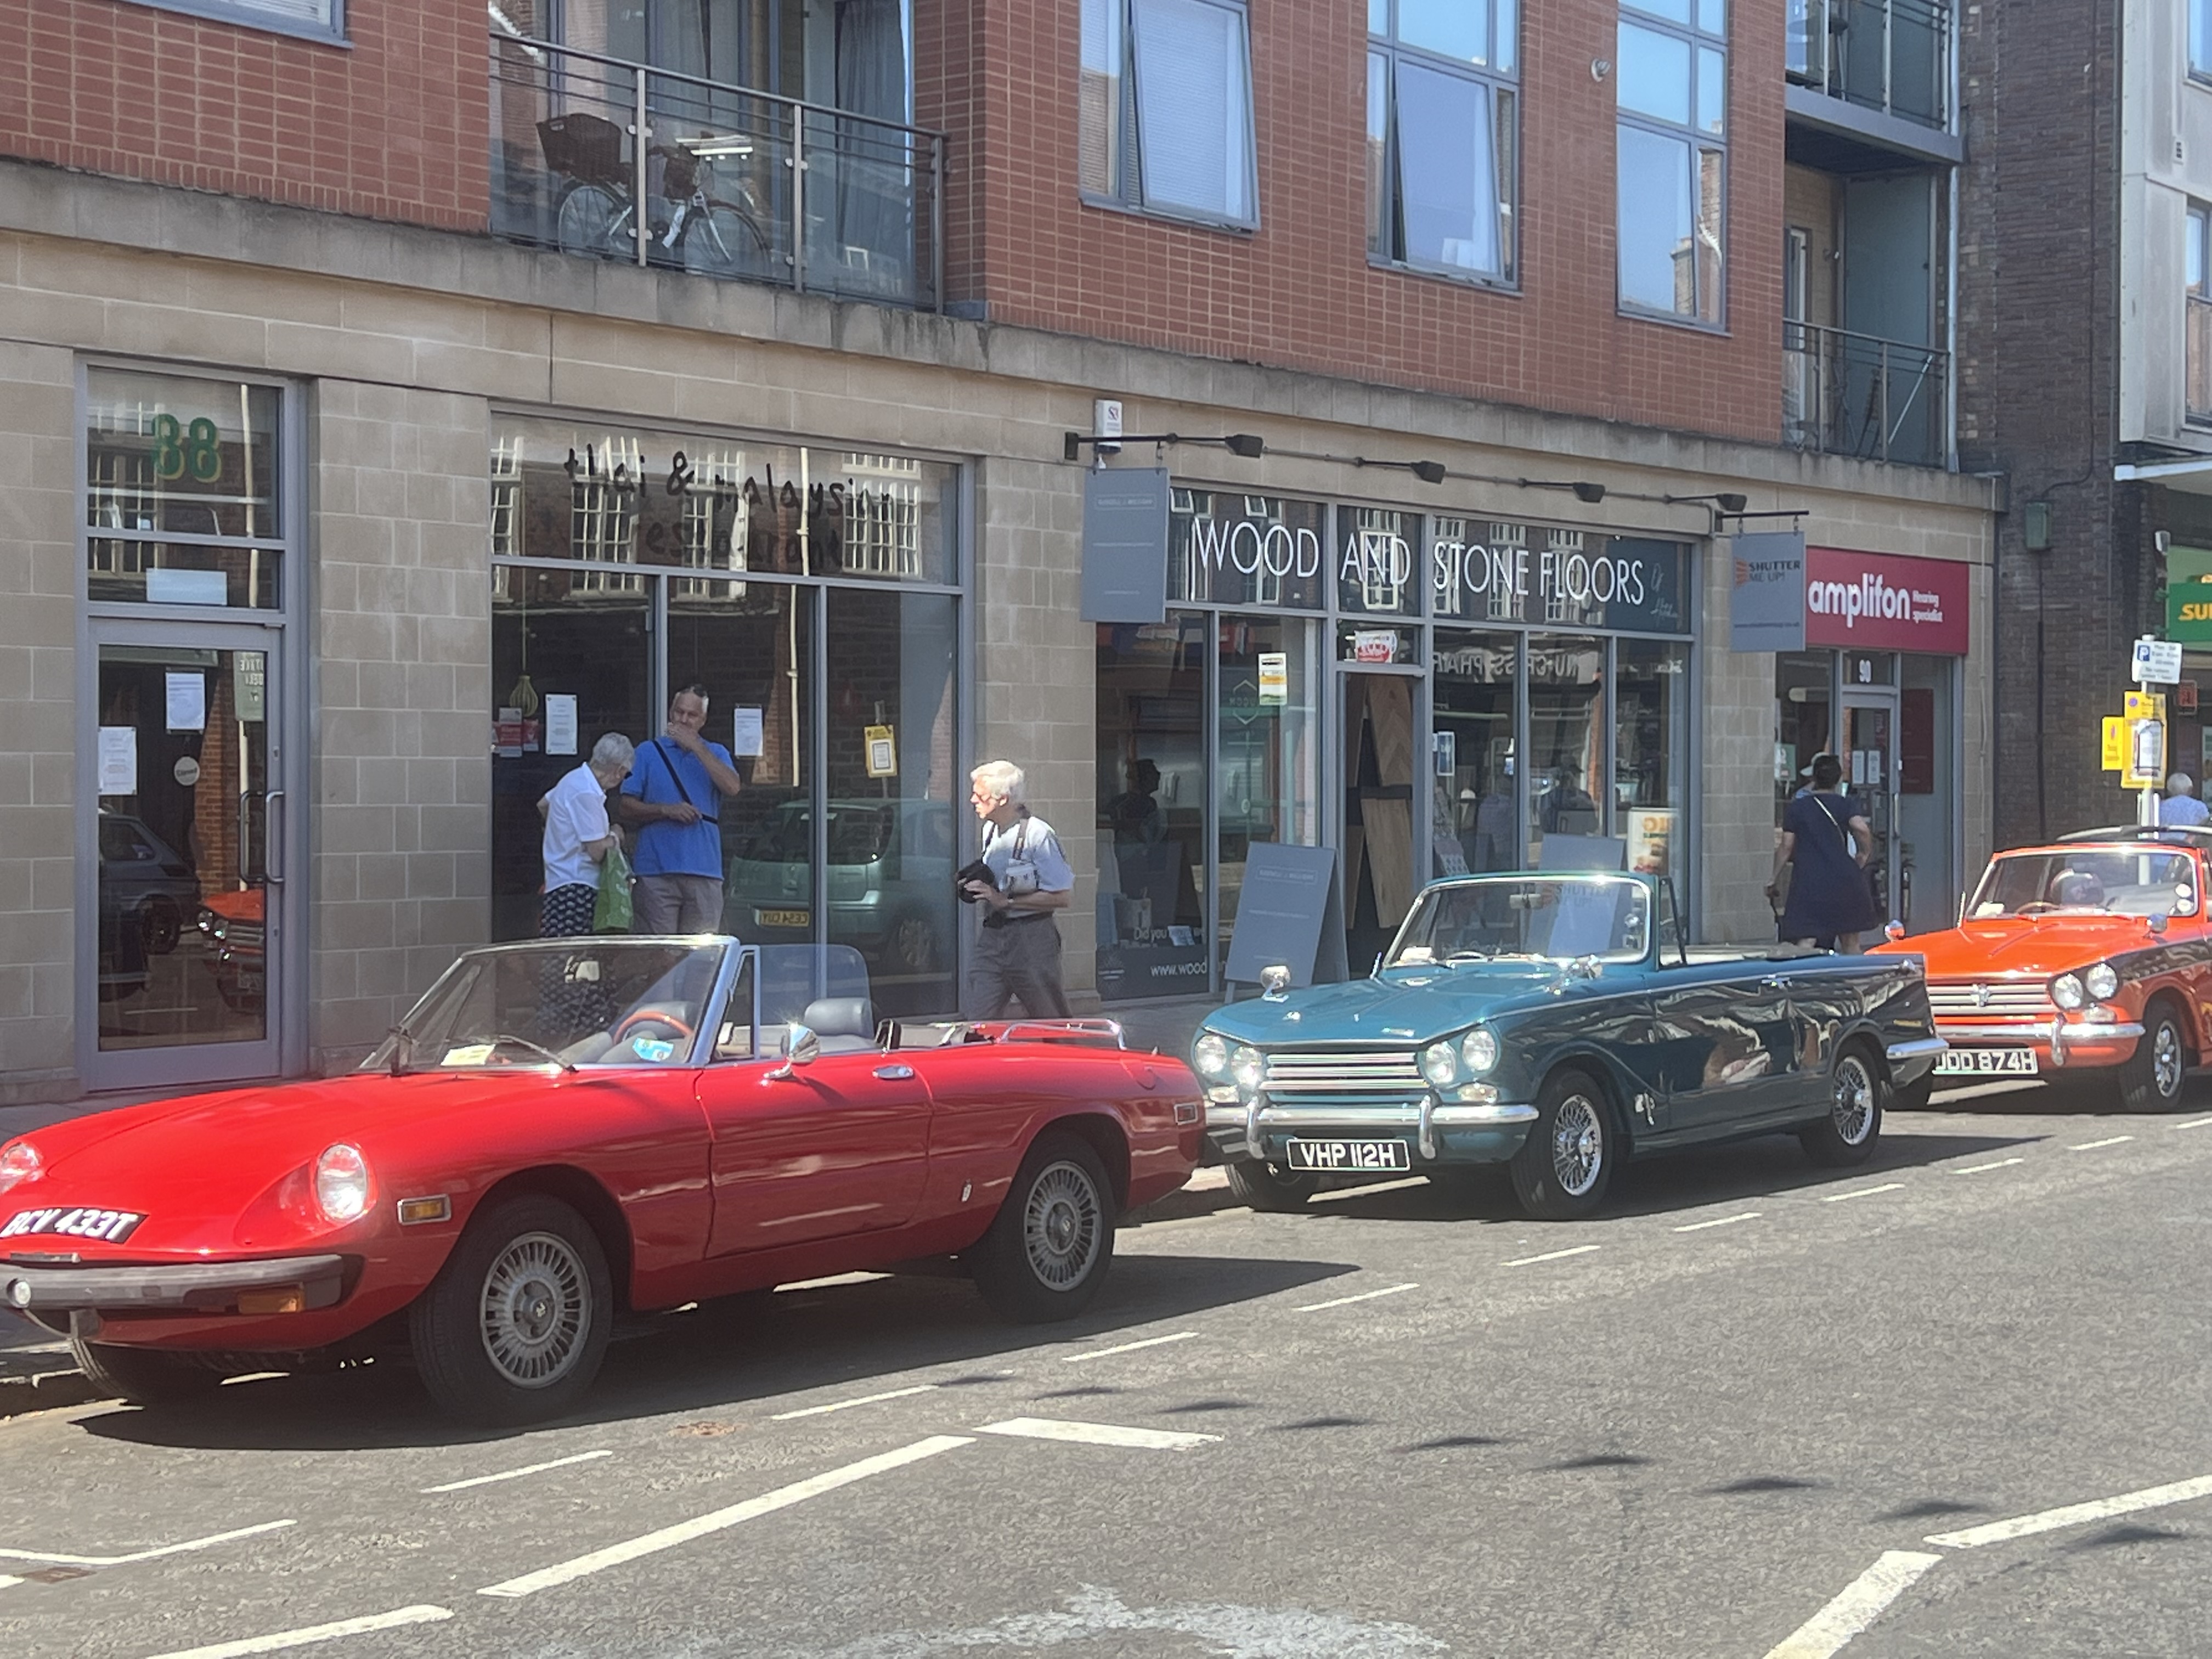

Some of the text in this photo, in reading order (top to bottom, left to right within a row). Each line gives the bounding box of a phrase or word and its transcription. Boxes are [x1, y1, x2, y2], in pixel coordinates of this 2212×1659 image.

[151, 413, 222, 483] 88
[665, 450, 695, 496] &
[1194, 516, 1320, 578] WOOD
[1340, 532, 1412, 586] AND
[1432, 541, 1530, 596] STONE
[1539, 551, 1645, 605] FLOORS
[1748, 560, 1801, 572] SHUTTER
[1808, 572, 1911, 629] amplifon
[1978, 1052, 2034, 1071] 874H
[1300, 1143, 1396, 1167] VHP 112H
[54, 1208, 139, 1240] 433T
